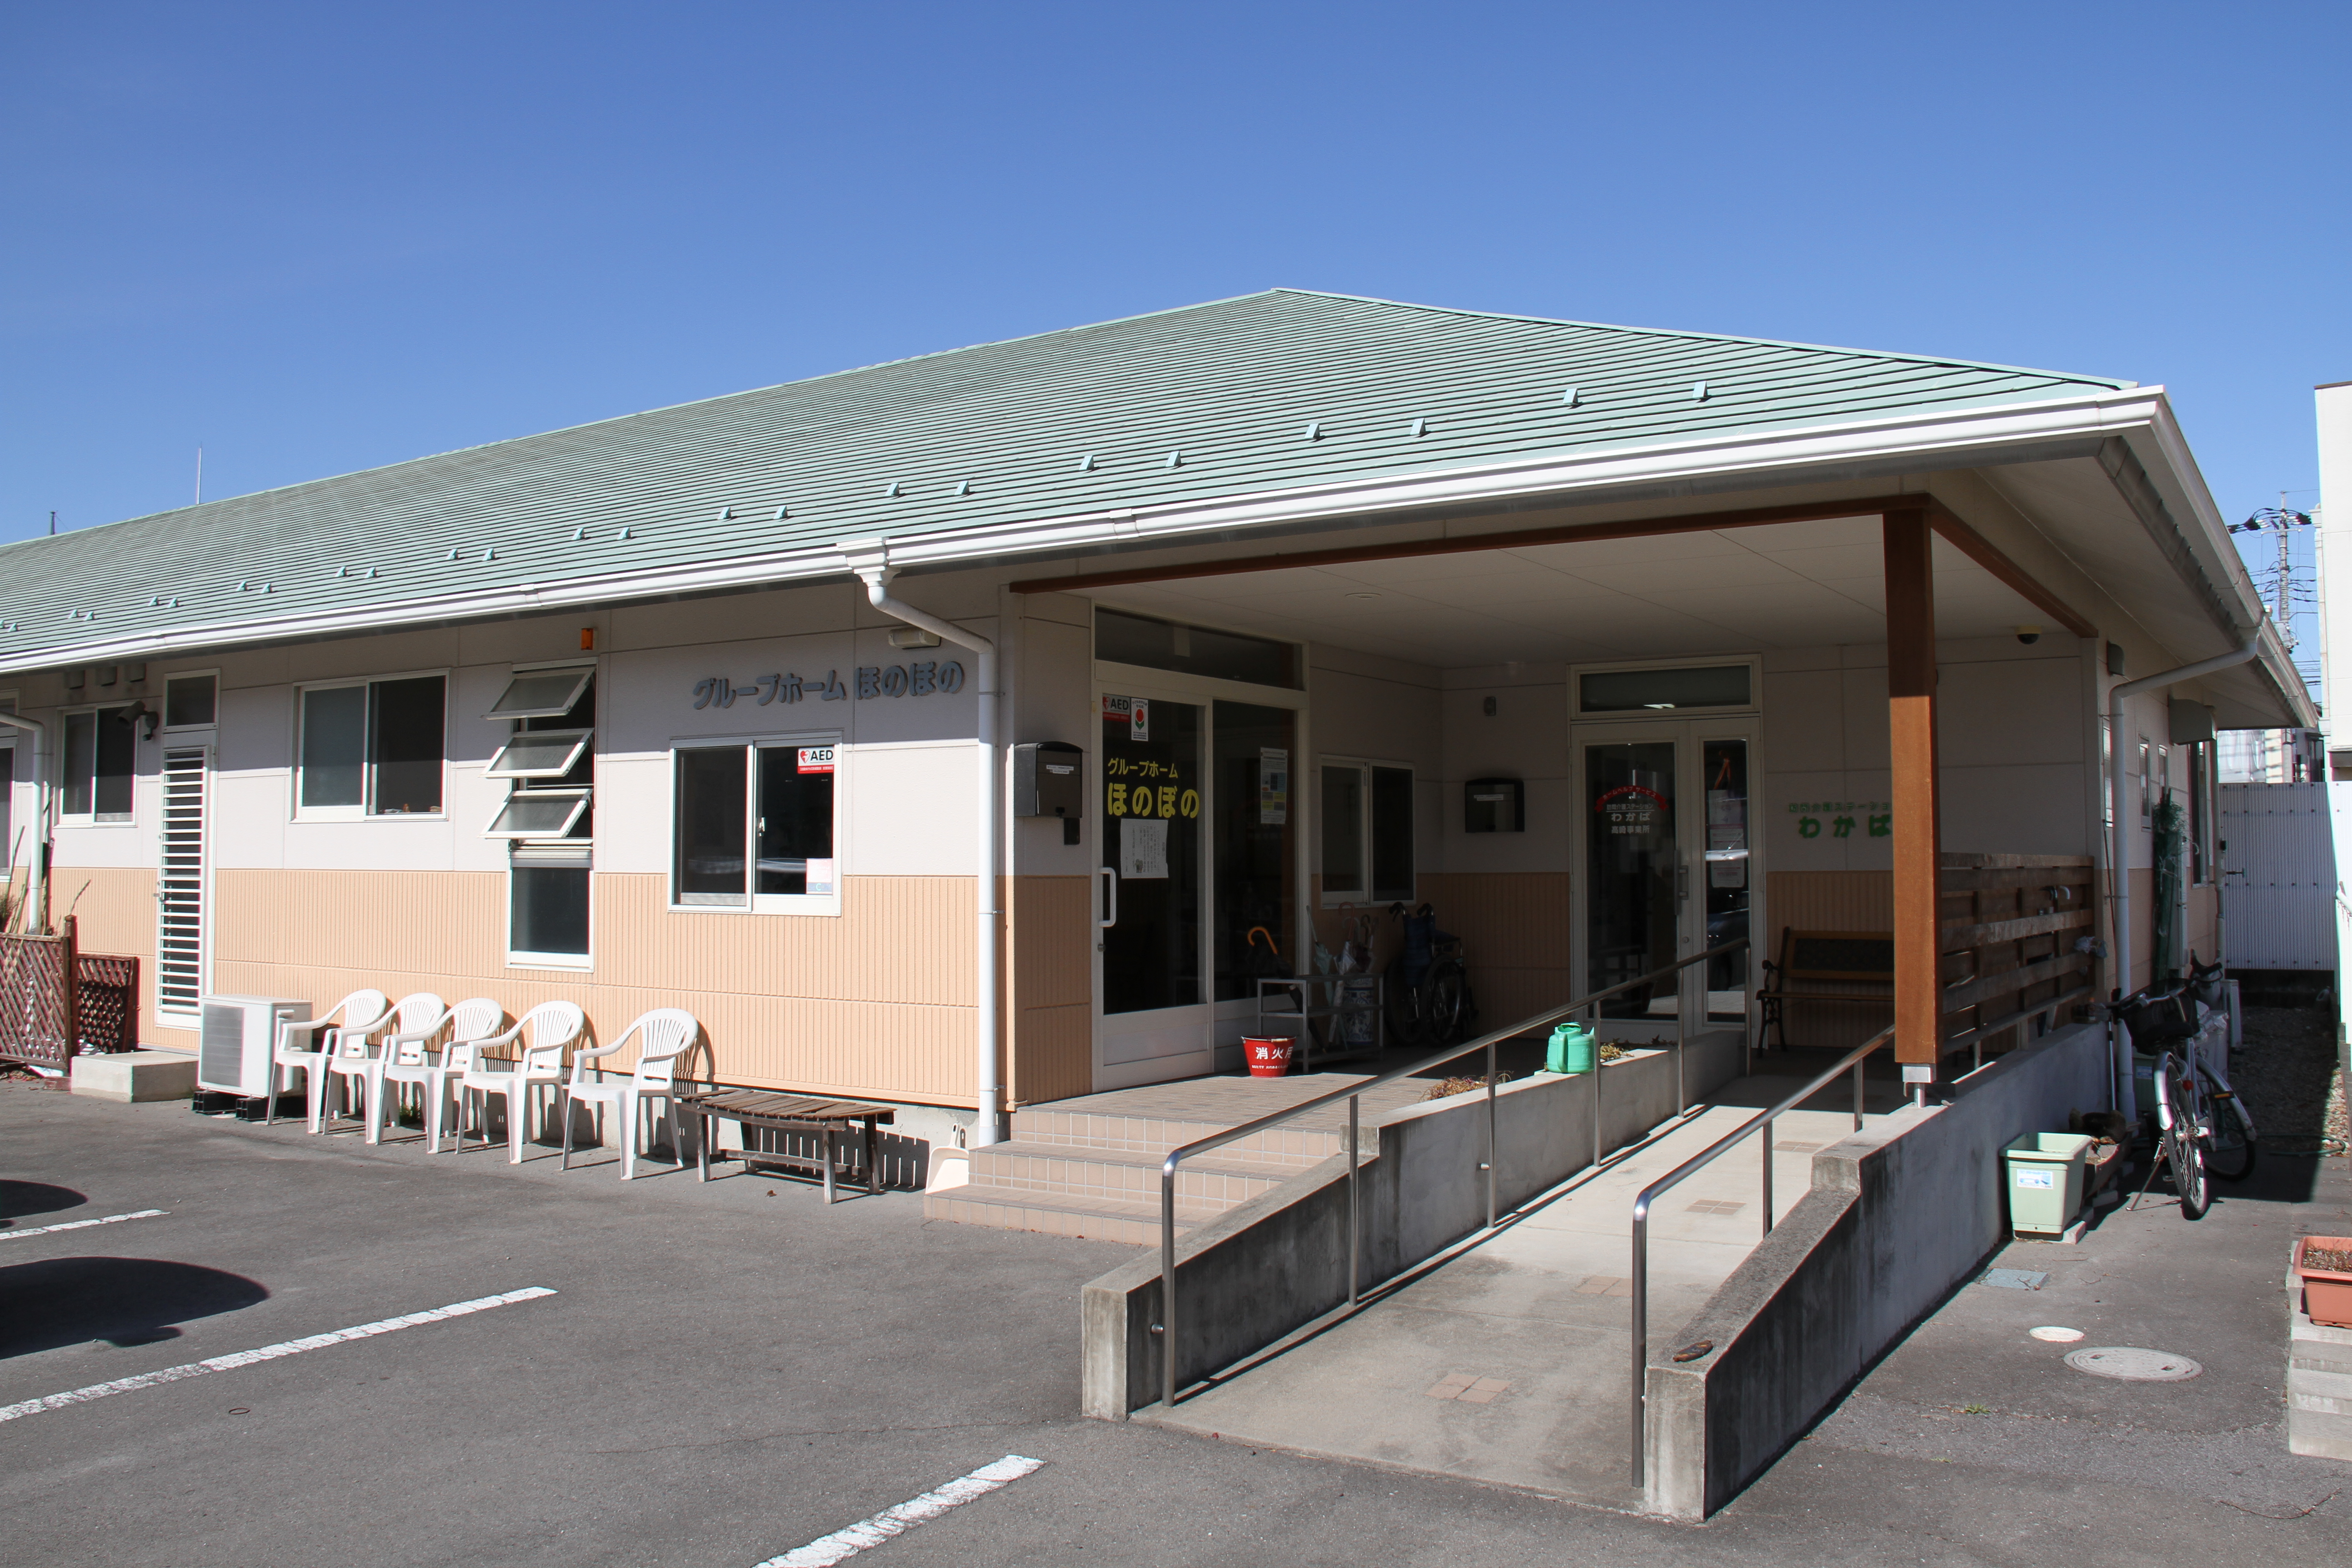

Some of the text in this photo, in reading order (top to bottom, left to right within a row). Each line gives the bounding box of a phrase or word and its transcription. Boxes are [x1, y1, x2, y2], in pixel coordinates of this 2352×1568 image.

[693, 661, 965, 710] グループホーム ほのぼの
[1110, 698, 1129, 710] AED
[810, 750, 833, 761] AED
[1107, 758, 1179, 779] グループホーム
[1602, 786, 1656, 800] ホームヘルプ サービス
[1107, 782, 1200, 818] ほのぼの
[1788, 801, 1890, 813] 訪問介護ステーショ
[1611, 812, 1651, 822] わかば
[1611, 825, 1650, 834] 高崎事業所
[1798, 814, 1891, 838] わかば
[1255, 1047, 1293, 1059] 消火用
